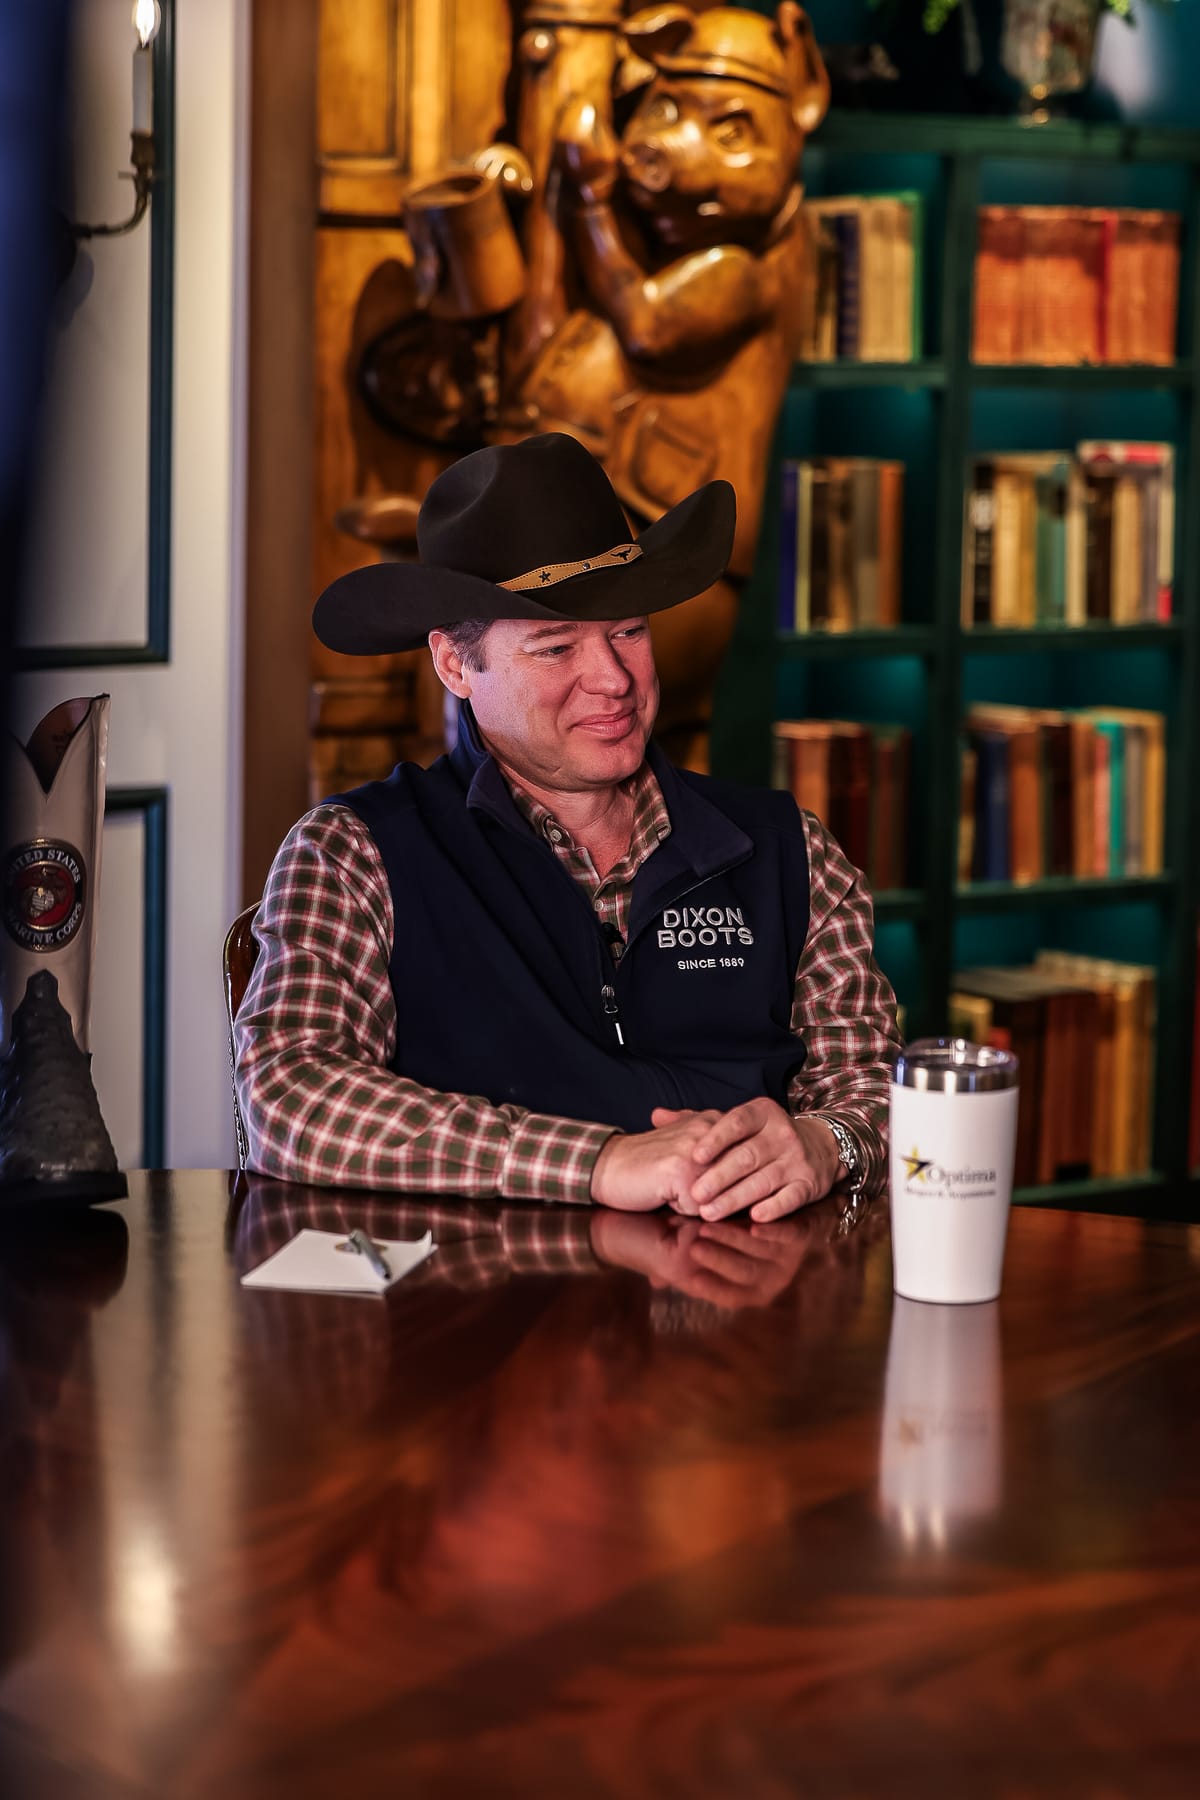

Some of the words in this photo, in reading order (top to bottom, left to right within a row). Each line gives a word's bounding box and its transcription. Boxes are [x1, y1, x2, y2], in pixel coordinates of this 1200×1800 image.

[47, 849, 81, 884] STATES
[56, 902, 82, 941] CORPS
[663, 907, 745, 928] DIXON
[657, 927, 754, 948] BOOTS
[677, 959, 717, 970] SINCE
[927, 1166, 996, 1187] Optima
